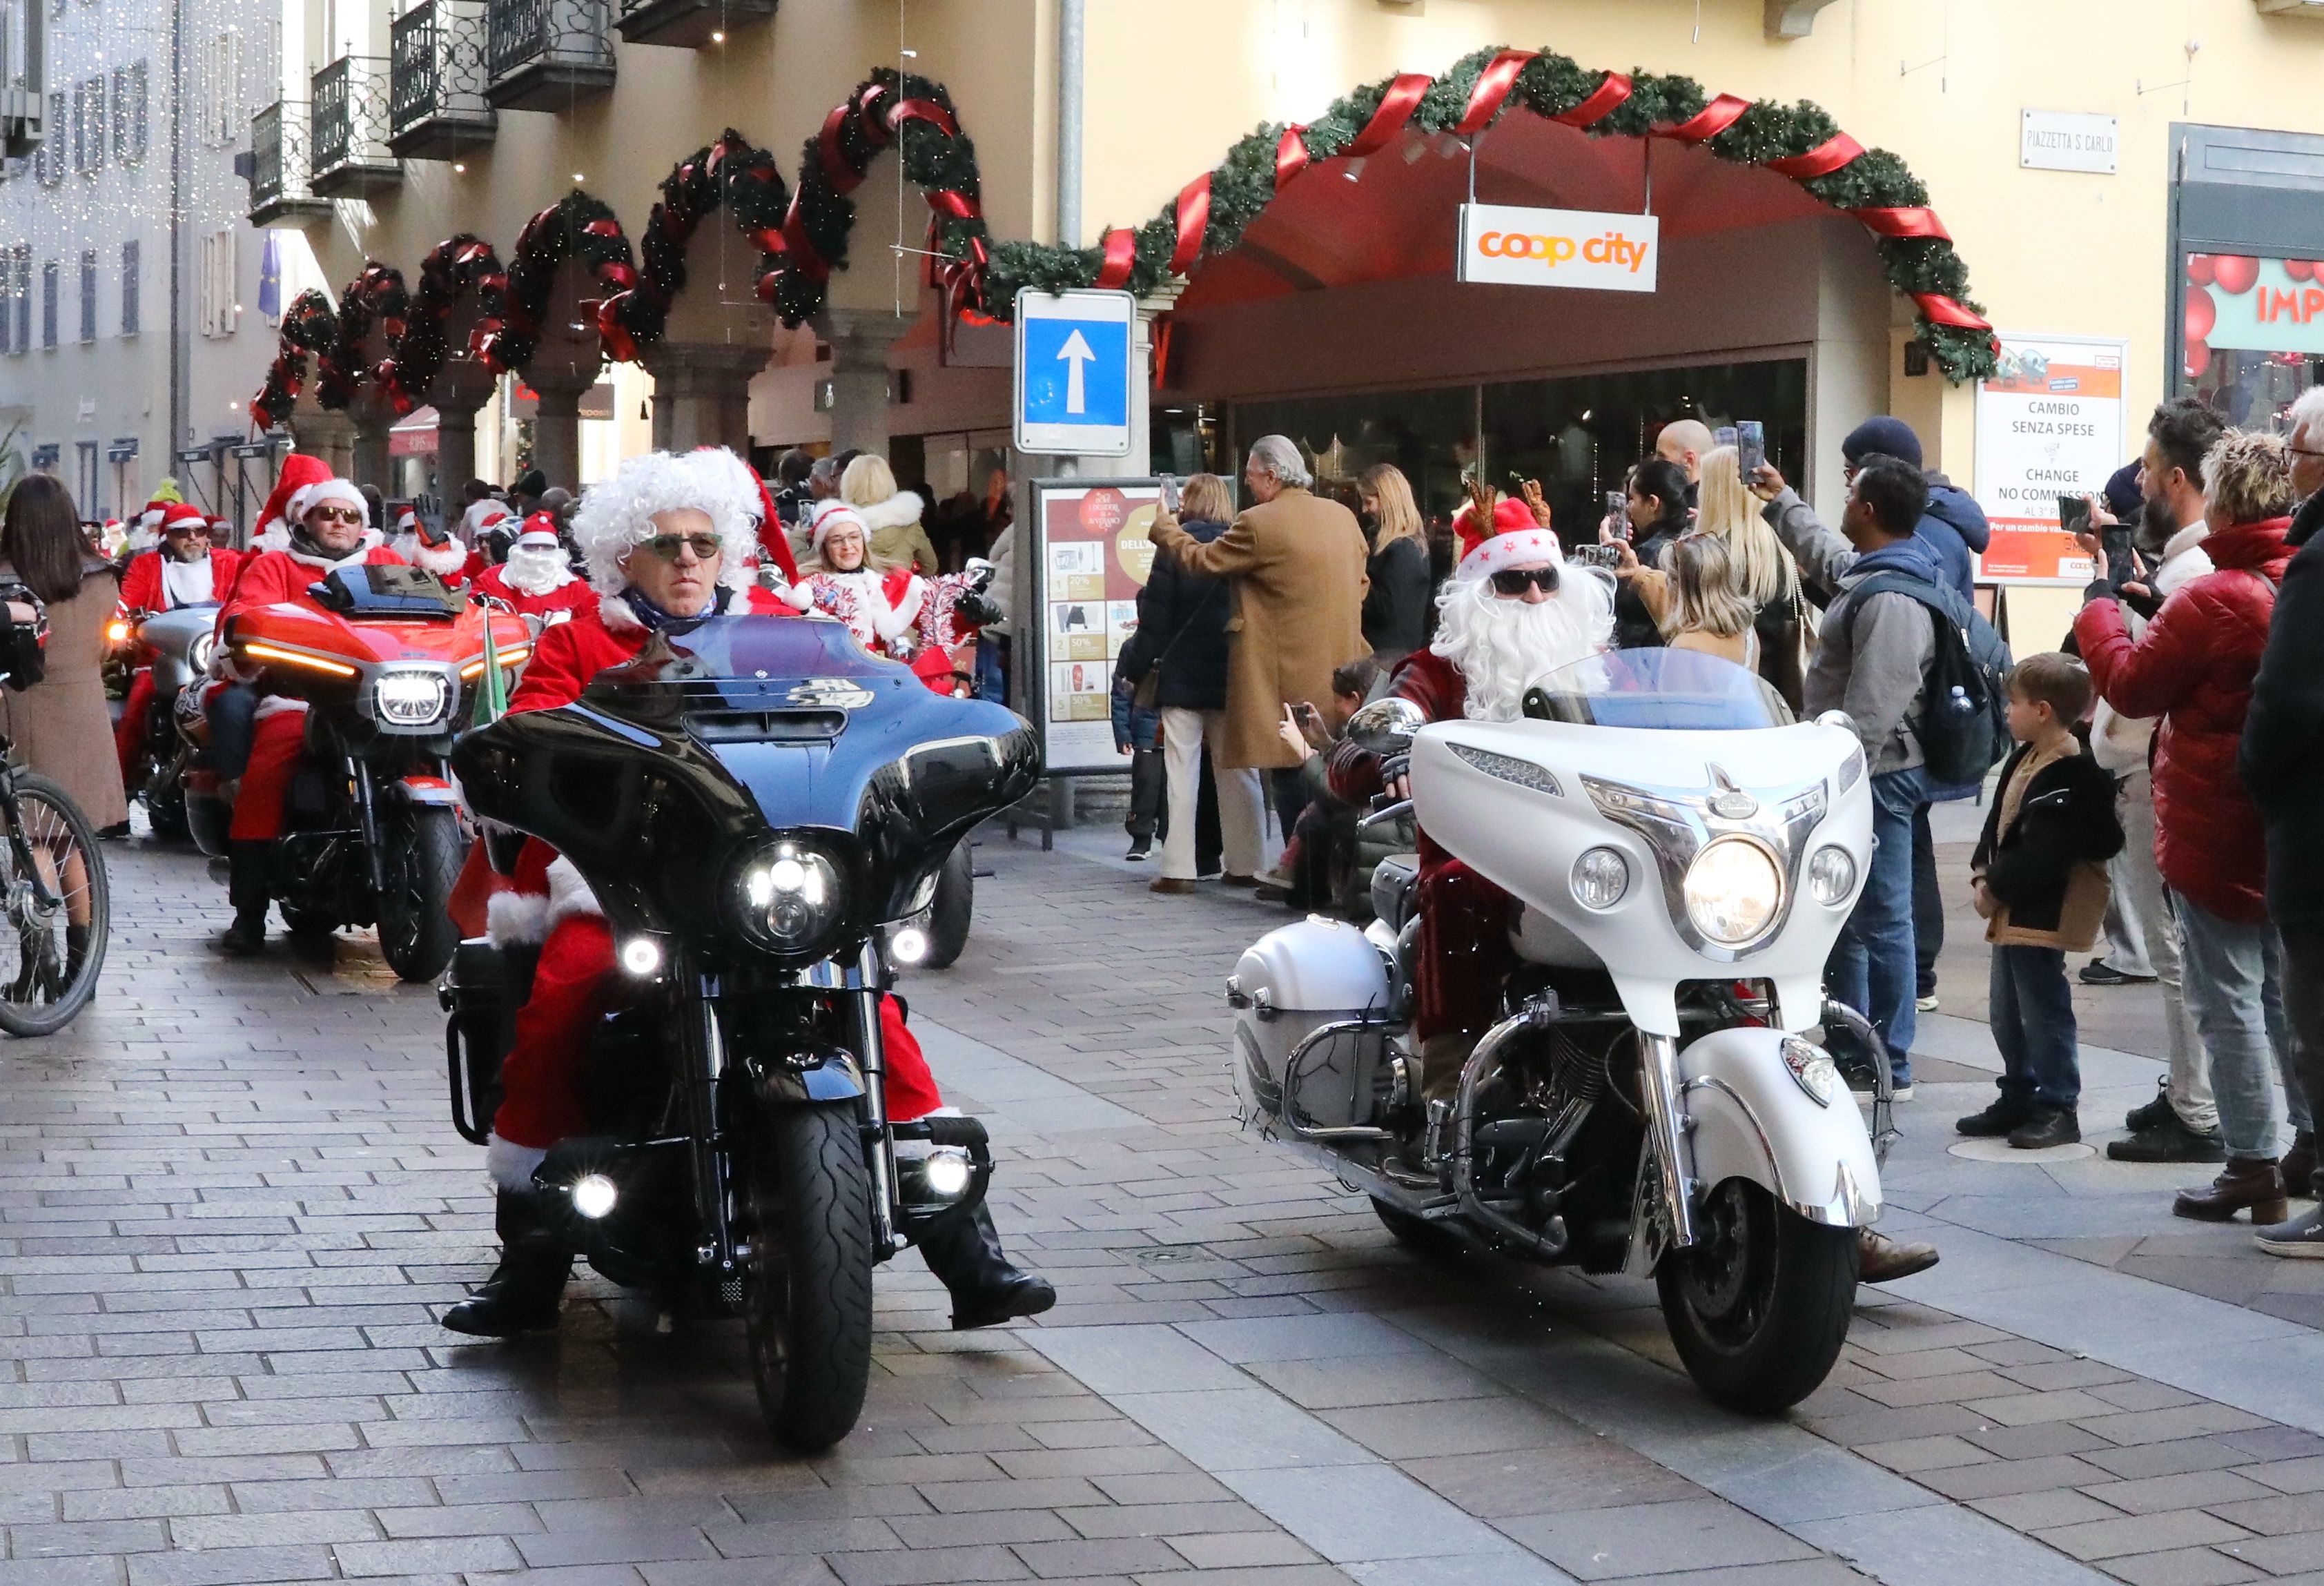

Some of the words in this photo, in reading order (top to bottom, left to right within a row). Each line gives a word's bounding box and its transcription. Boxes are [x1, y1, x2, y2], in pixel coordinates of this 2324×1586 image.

[2027, 130, 2072, 150] PIAZZETTA
[2085, 135, 2113, 153] CARLO
[1478, 231, 1576, 268] coop
[1583, 231, 1648, 273] city
[2028, 402, 2080, 415] CAMBIO
[2012, 421, 2053, 435] SENZA
[2058, 422, 2095, 436] SPESE
[2026, 469, 2079, 482] CHANGE
[1999, 487, 2018, 500] NO
[2024, 506, 2035, 516] AL
[1989, 522, 2004, 531] Per
[2018, 523, 2048, 532] cambio
[2070, 562, 2091, 571] coop
[1056, 580, 1061, 591] 1
[1069, 576, 1089, 585] 20%
[1057, 640, 1064, 650] 2
[1071, 638, 1091, 647] 50%
[1072, 695, 1092, 705] 50%
[2304, 1224, 2323, 1235] FILA
